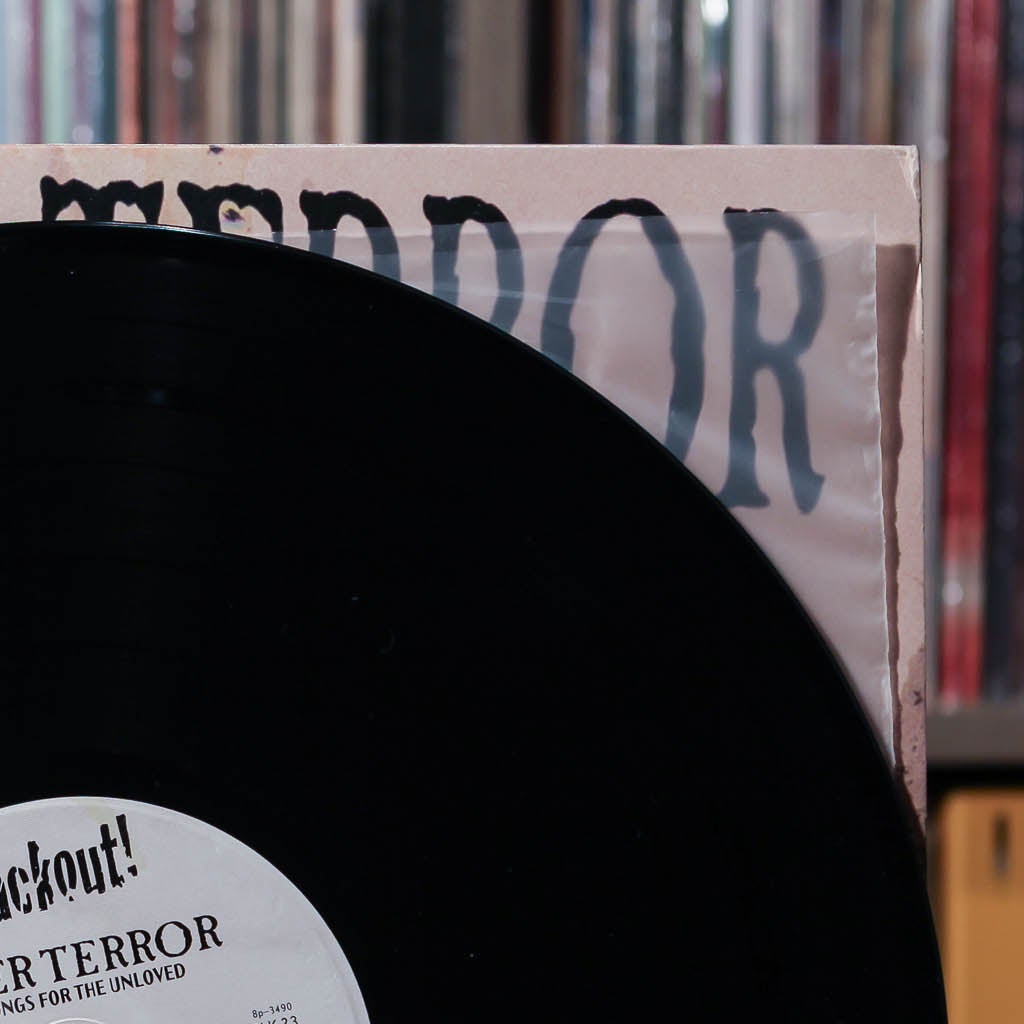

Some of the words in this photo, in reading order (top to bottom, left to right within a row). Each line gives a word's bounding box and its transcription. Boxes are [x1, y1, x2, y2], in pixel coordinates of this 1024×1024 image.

[39, 914, 223, 985] TERROR
[39, 986, 72, 1008] FOR
[73, 977, 107, 1000] THE
[109, 962, 186, 993] UNLOVED
